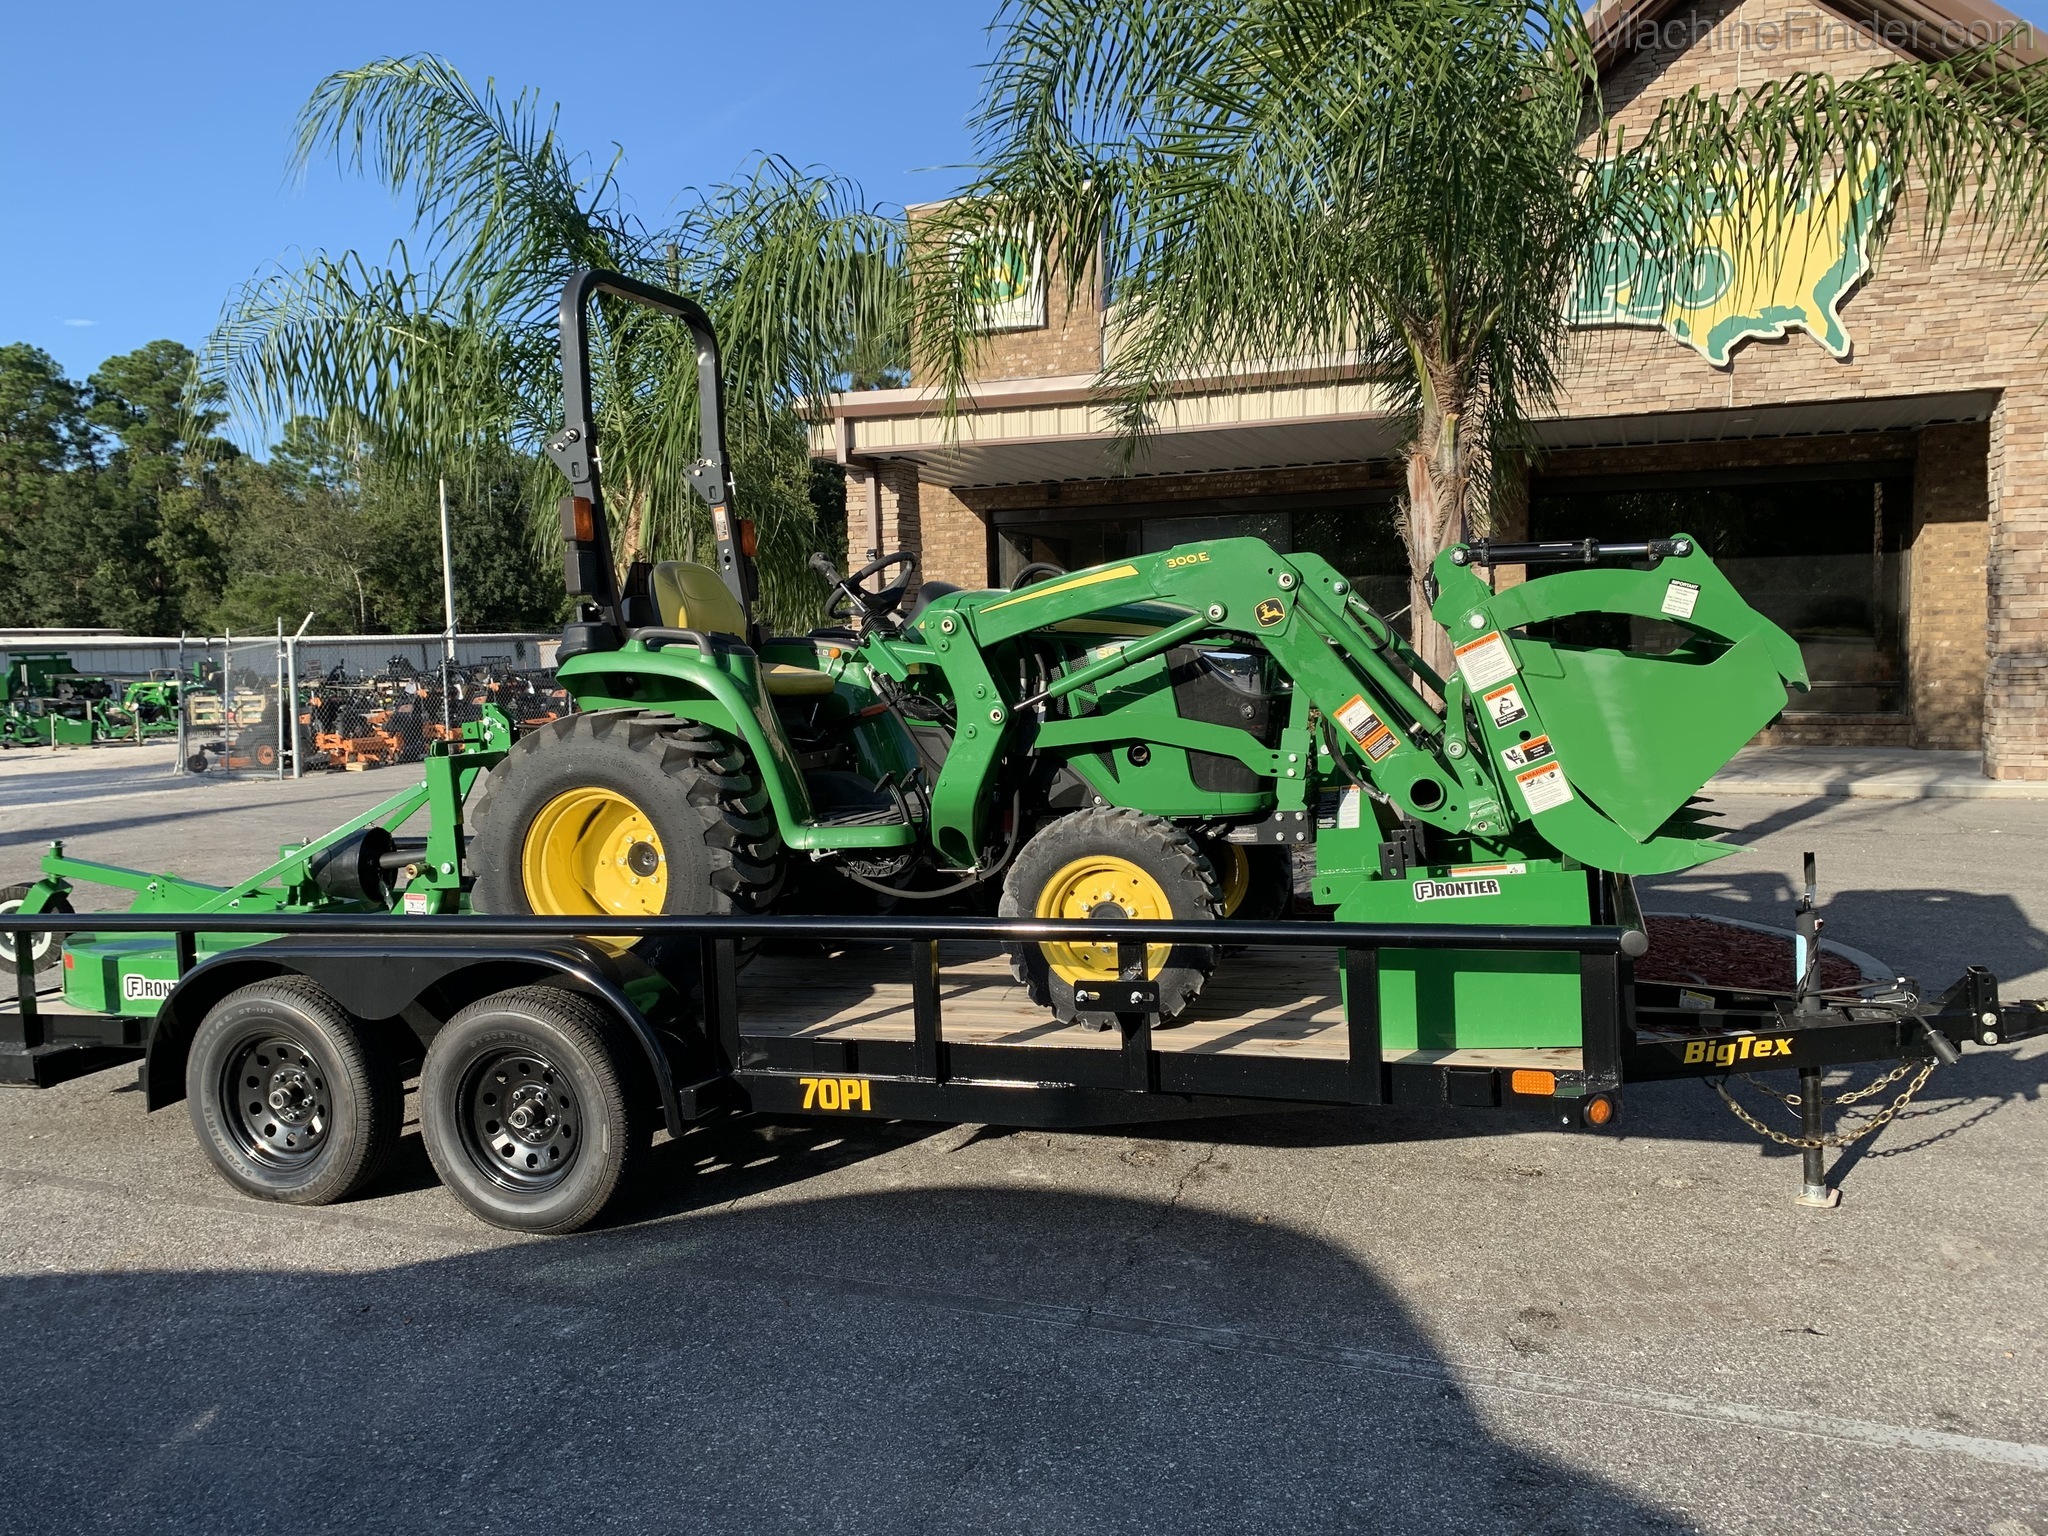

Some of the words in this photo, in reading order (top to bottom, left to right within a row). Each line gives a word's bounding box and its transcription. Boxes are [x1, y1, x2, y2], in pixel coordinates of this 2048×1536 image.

[1166, 552, 1210, 568] 300E
[1671, 579, 1699, 590] IMPORTANT
[1415, 881, 1498, 900] FRONTIER
[238, 1007, 274, 1015] ST-100
[800, 1078, 871, 1111] 70PI
